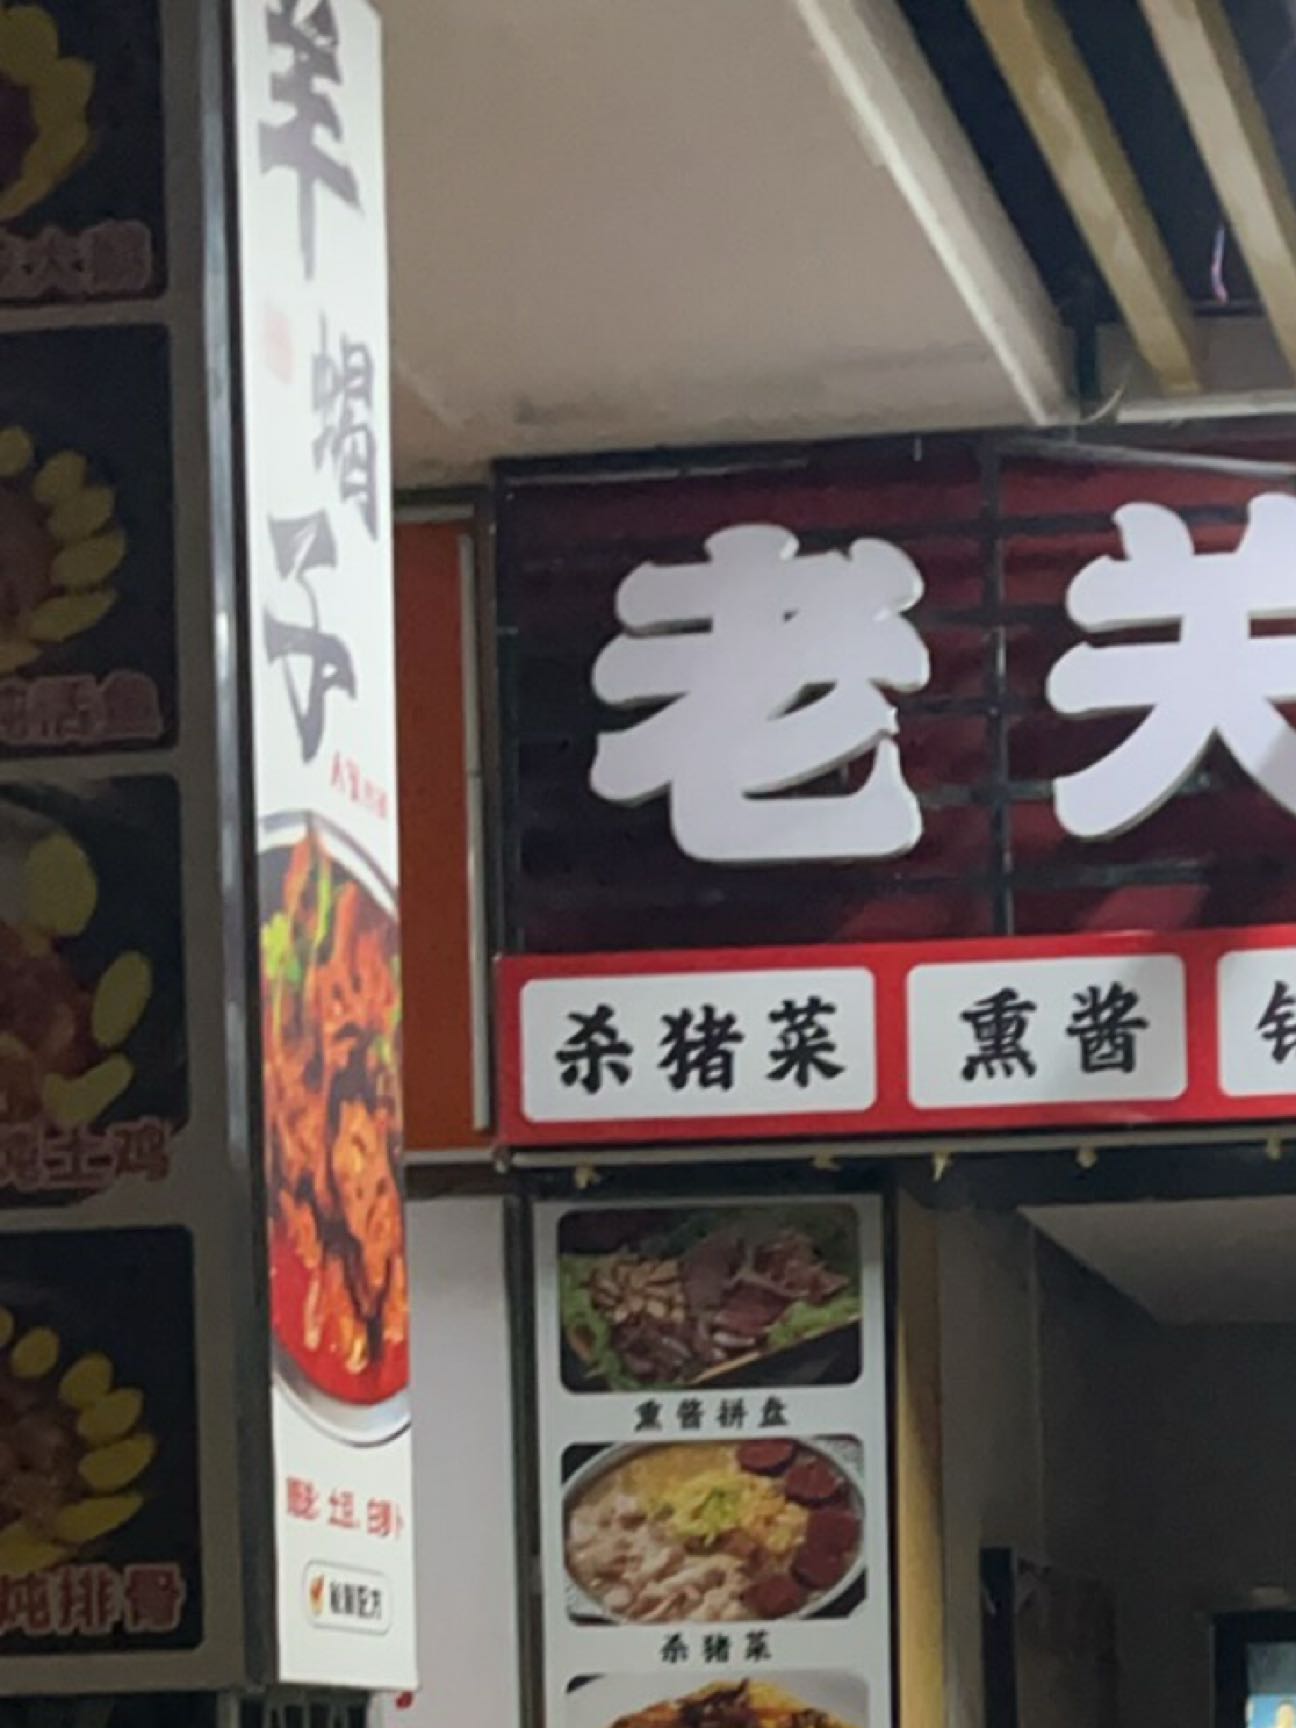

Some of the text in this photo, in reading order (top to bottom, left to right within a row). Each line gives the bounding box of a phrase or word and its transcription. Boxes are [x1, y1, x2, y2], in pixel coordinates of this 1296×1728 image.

[554, 995, 847, 1094] 杀猪菜
[960, 981, 1150, 1082] 熏酱
[660, 1630, 772, 1664] 杀猪菜
